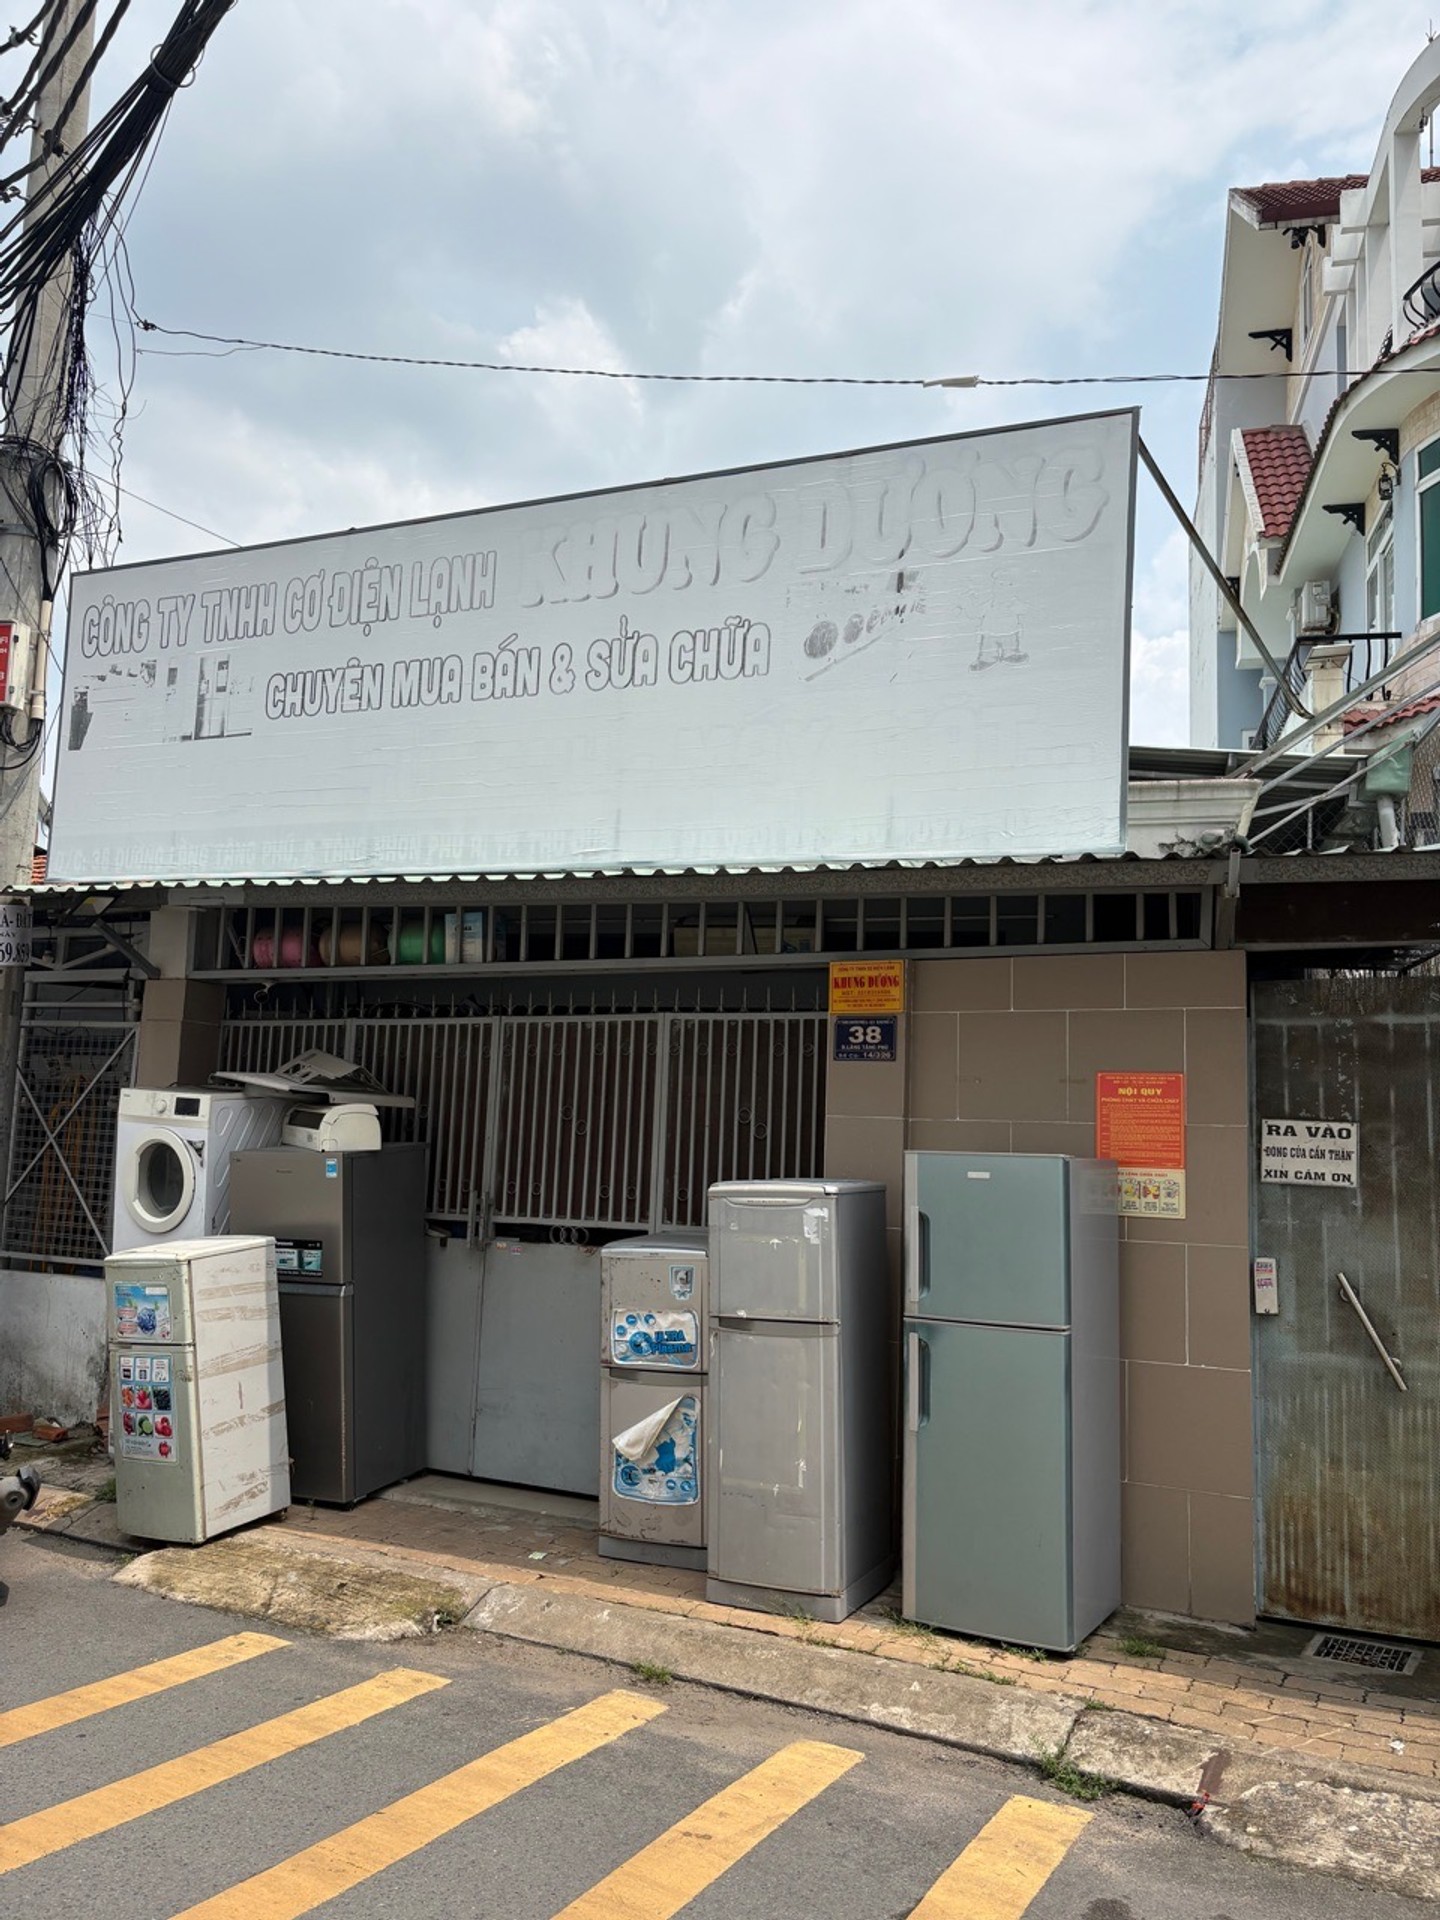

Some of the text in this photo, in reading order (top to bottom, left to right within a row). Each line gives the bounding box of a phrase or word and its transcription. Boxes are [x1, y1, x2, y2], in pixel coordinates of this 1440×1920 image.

[82, 594, 150, 658] CÔNG
[158, 594, 195, 648] TY
[202, 582, 277, 643] TNHH
[284, 568, 325, 634] CƠ
[328, 557, 403, 637] ĐIỆN
[410, 551, 497, 628] LẠNH
[518, 493, 781, 609] KHUNG
[266, 614, 771, 720] CHUYÊN MUA BÁN & SỬA CHỮA
[848, 1026, 882, 1043] 38
[1118, 1087, 1162, 1097] NỘI QUY
[1266, 1125, 1297, 1137] RA
[1263, 1169, 1288, 1179] XIN
